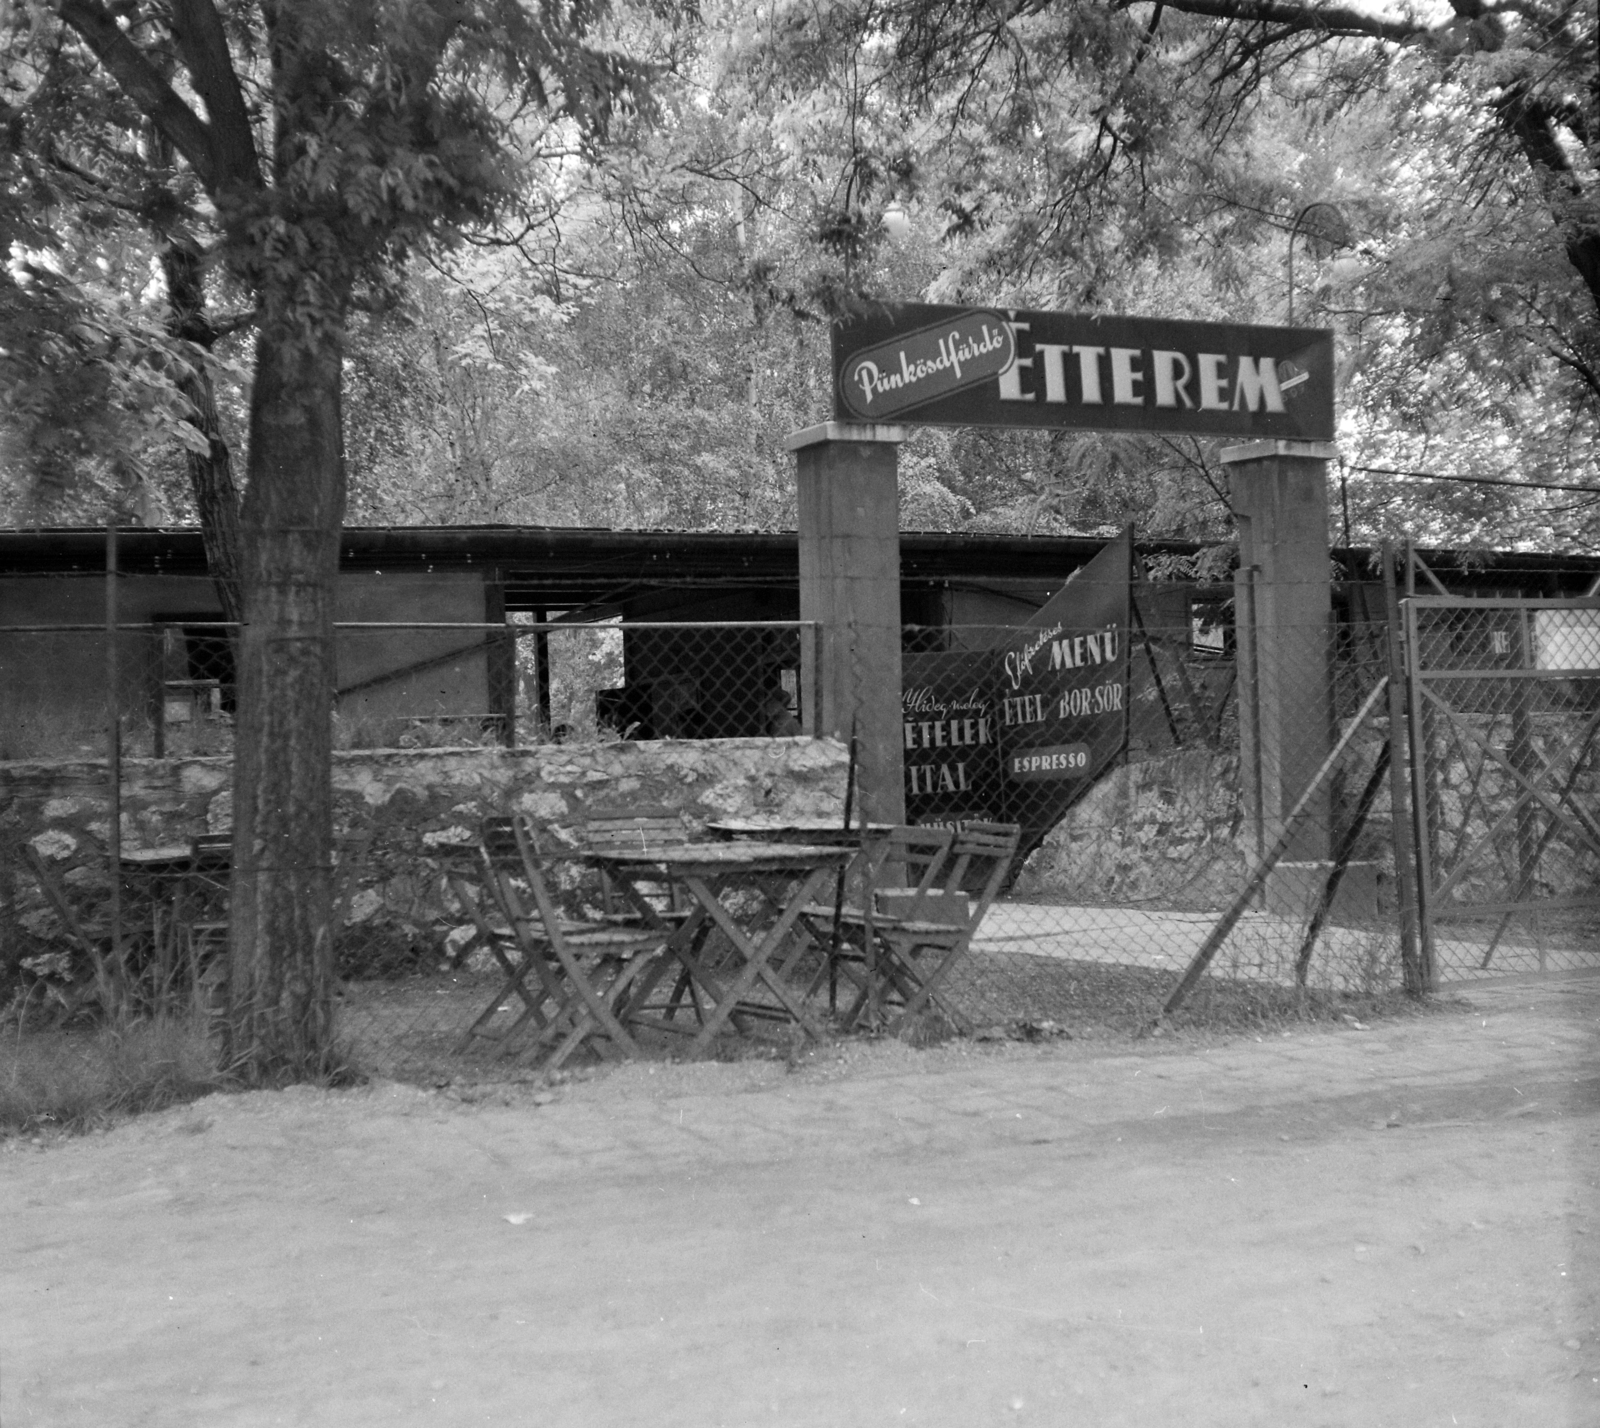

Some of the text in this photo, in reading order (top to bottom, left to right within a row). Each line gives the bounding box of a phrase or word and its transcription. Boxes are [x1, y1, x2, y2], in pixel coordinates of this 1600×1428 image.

[854, 323, 1004, 405] Pünkösdfürdő
[998, 310, 1286, 413] ÉTTEREM
[1048, 623, 1118, 671] MENÜ
[1002, 688, 1047, 726] ÉTEL
[904, 717, 993, 749] ÉTELEK
[909, 762, 972, 795] ITAL
[1014, 752, 1087, 773] ESPRESSO
